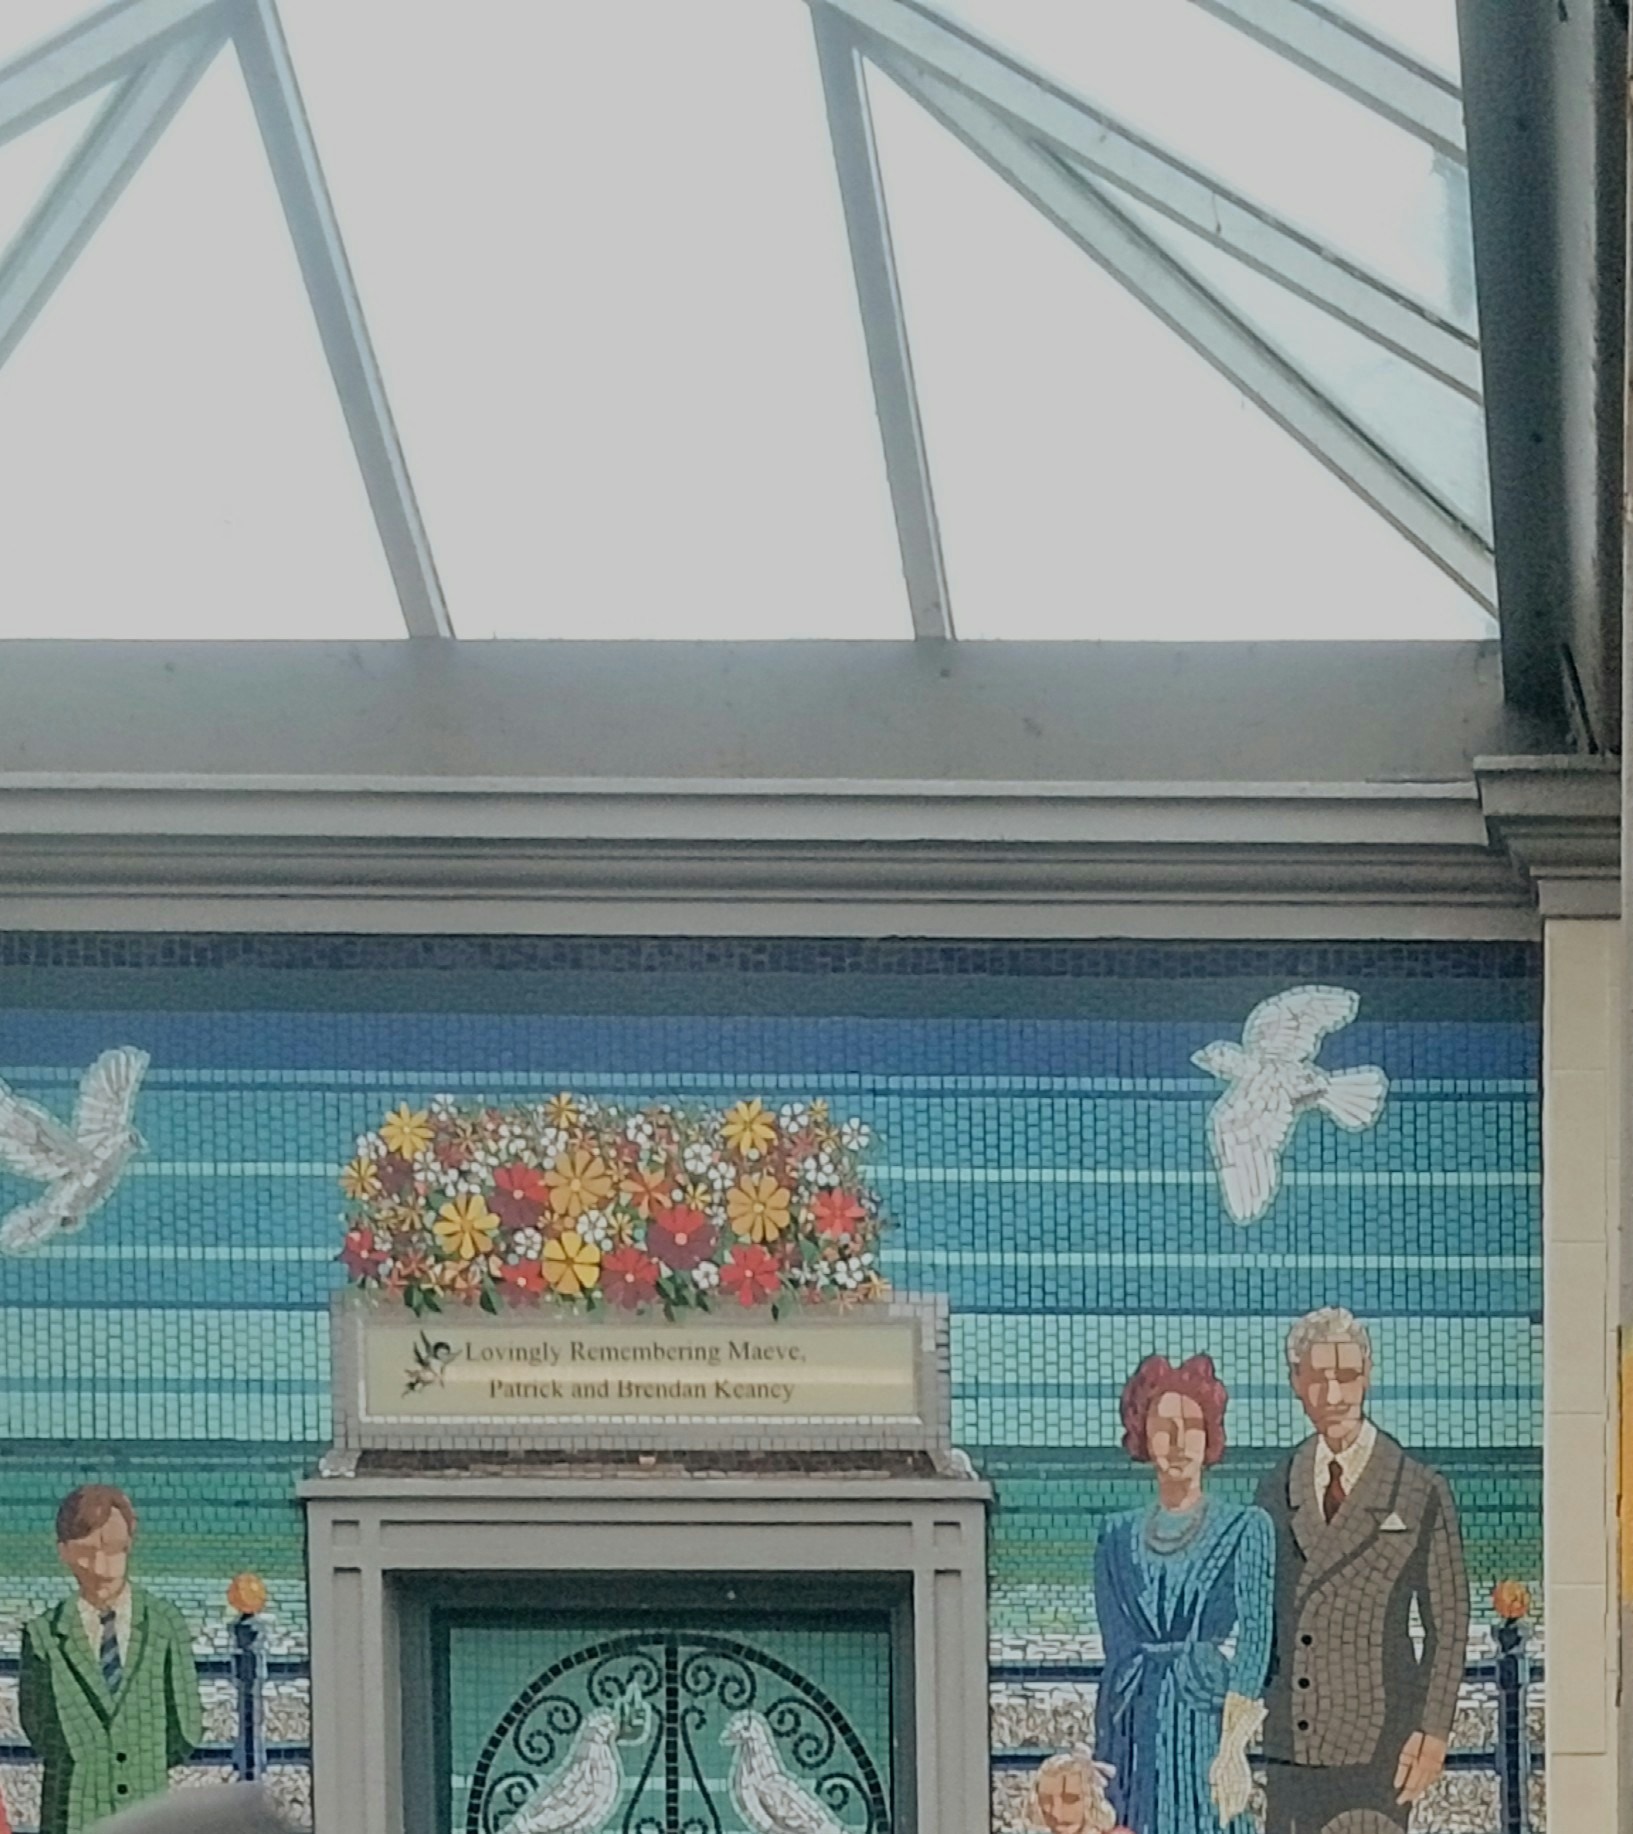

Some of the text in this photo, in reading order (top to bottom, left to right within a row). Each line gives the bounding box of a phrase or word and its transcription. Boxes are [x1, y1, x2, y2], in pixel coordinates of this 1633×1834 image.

[465, 1341, 806, 1366] Lovingly Remembering Maeve,
[489, 1379, 795, 1403] Patrick and Brendan Keaney
